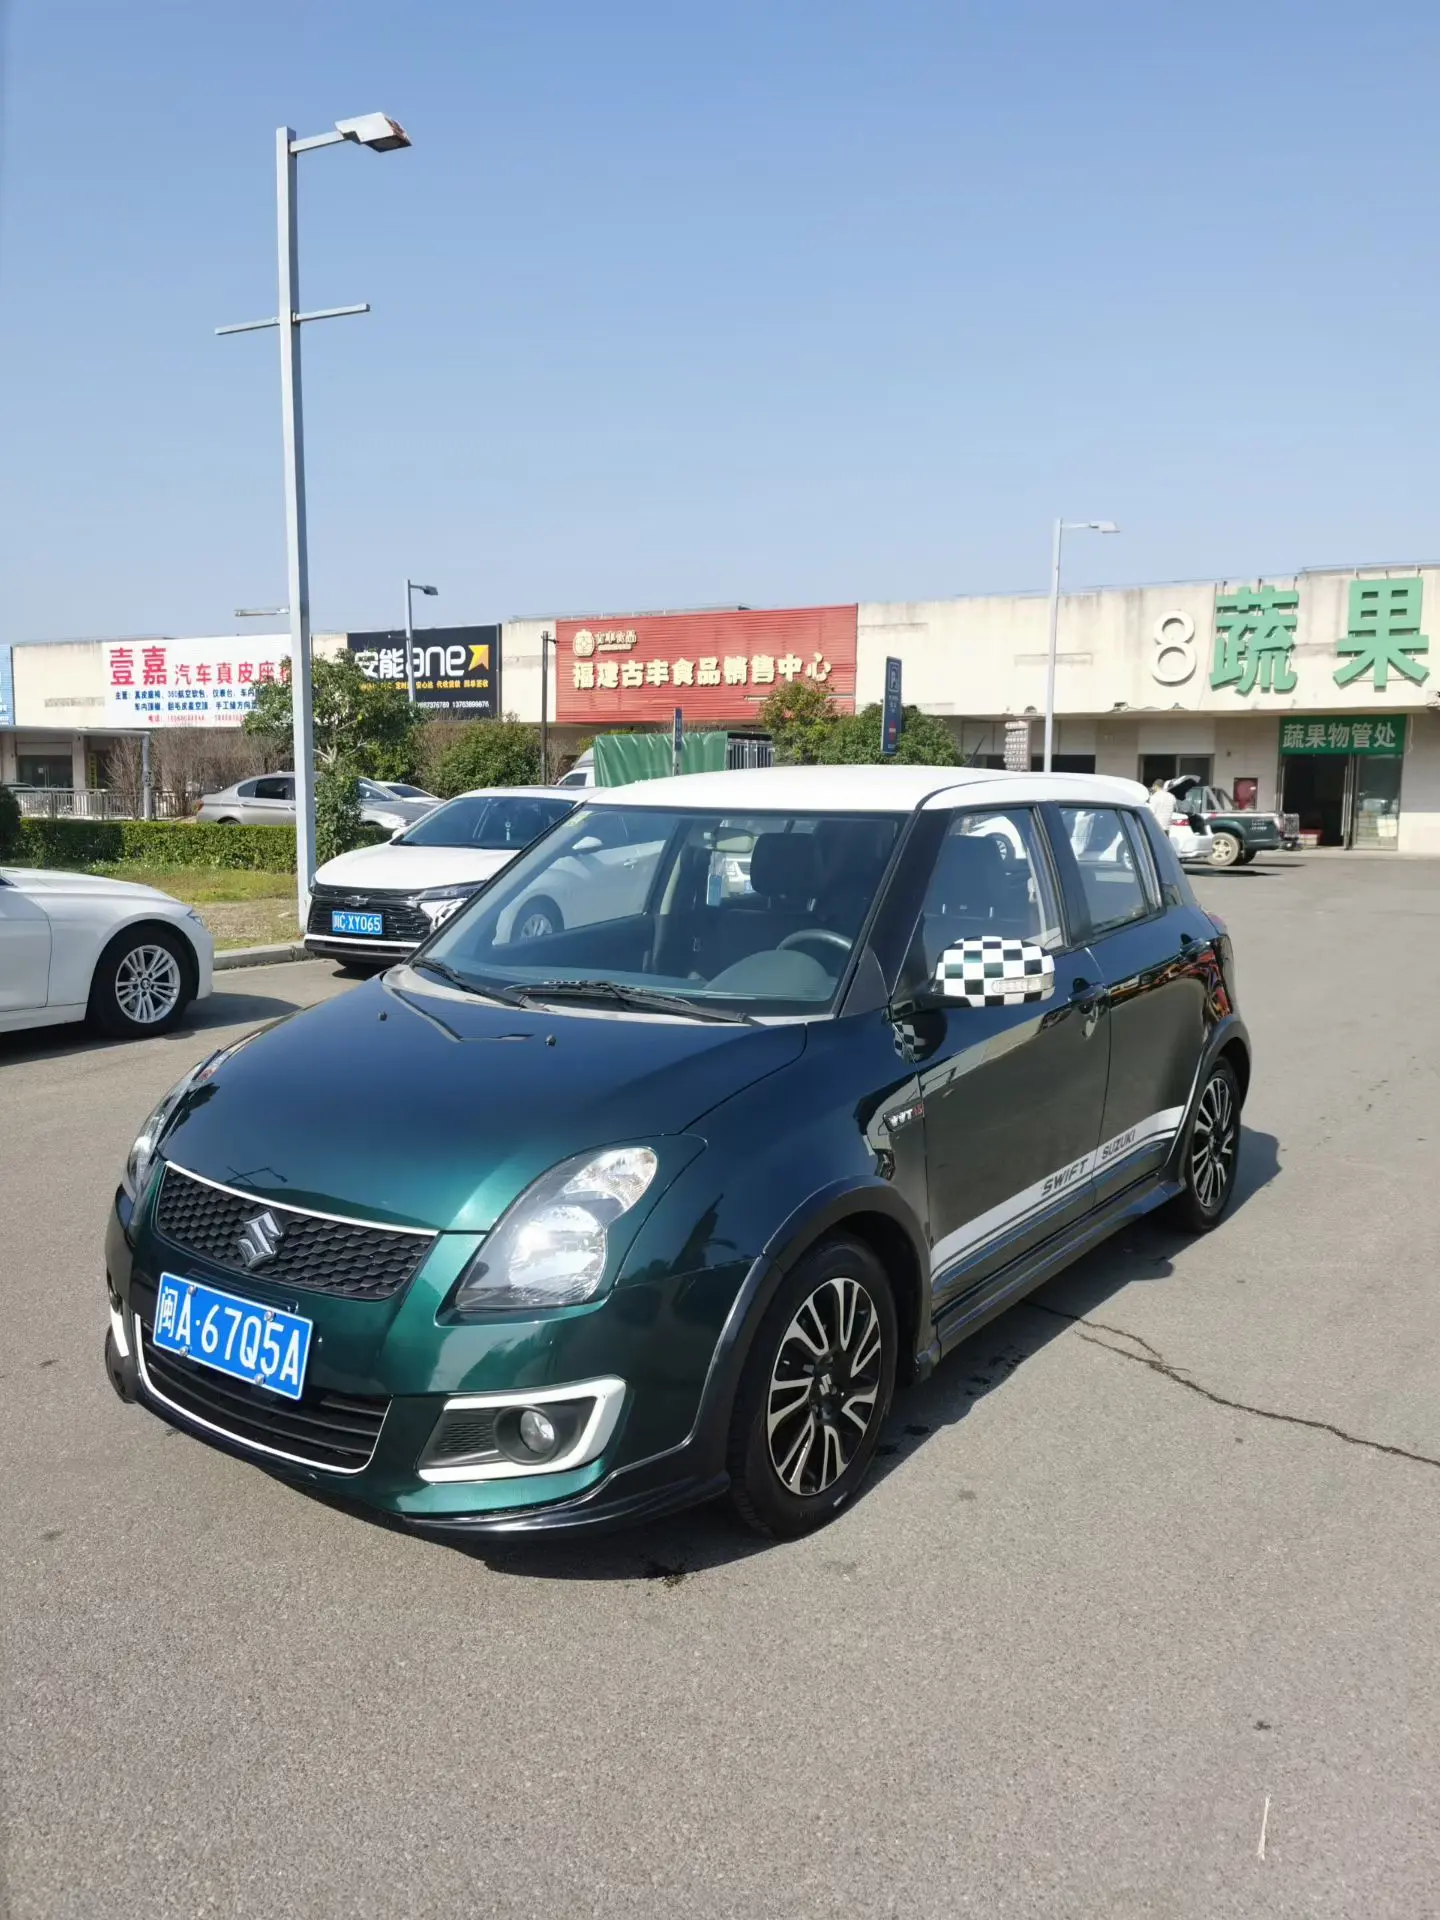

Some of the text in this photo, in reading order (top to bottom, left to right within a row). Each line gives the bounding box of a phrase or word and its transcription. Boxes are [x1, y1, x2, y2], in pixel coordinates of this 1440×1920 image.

[109, 645, 167, 686] 壹嘉
[573, 652, 831, 689] 福建古丰食品销售中心
[1152, 610, 1197, 684] 8
[1209, 578, 1430, 697] 蔬果
[1282, 723, 1396, 748] 蔬果物管处
[1041, 1128, 1136, 1197] SWIFT SUZUKI
[157, 1285, 300, 1386] 闽A·67Q5A
